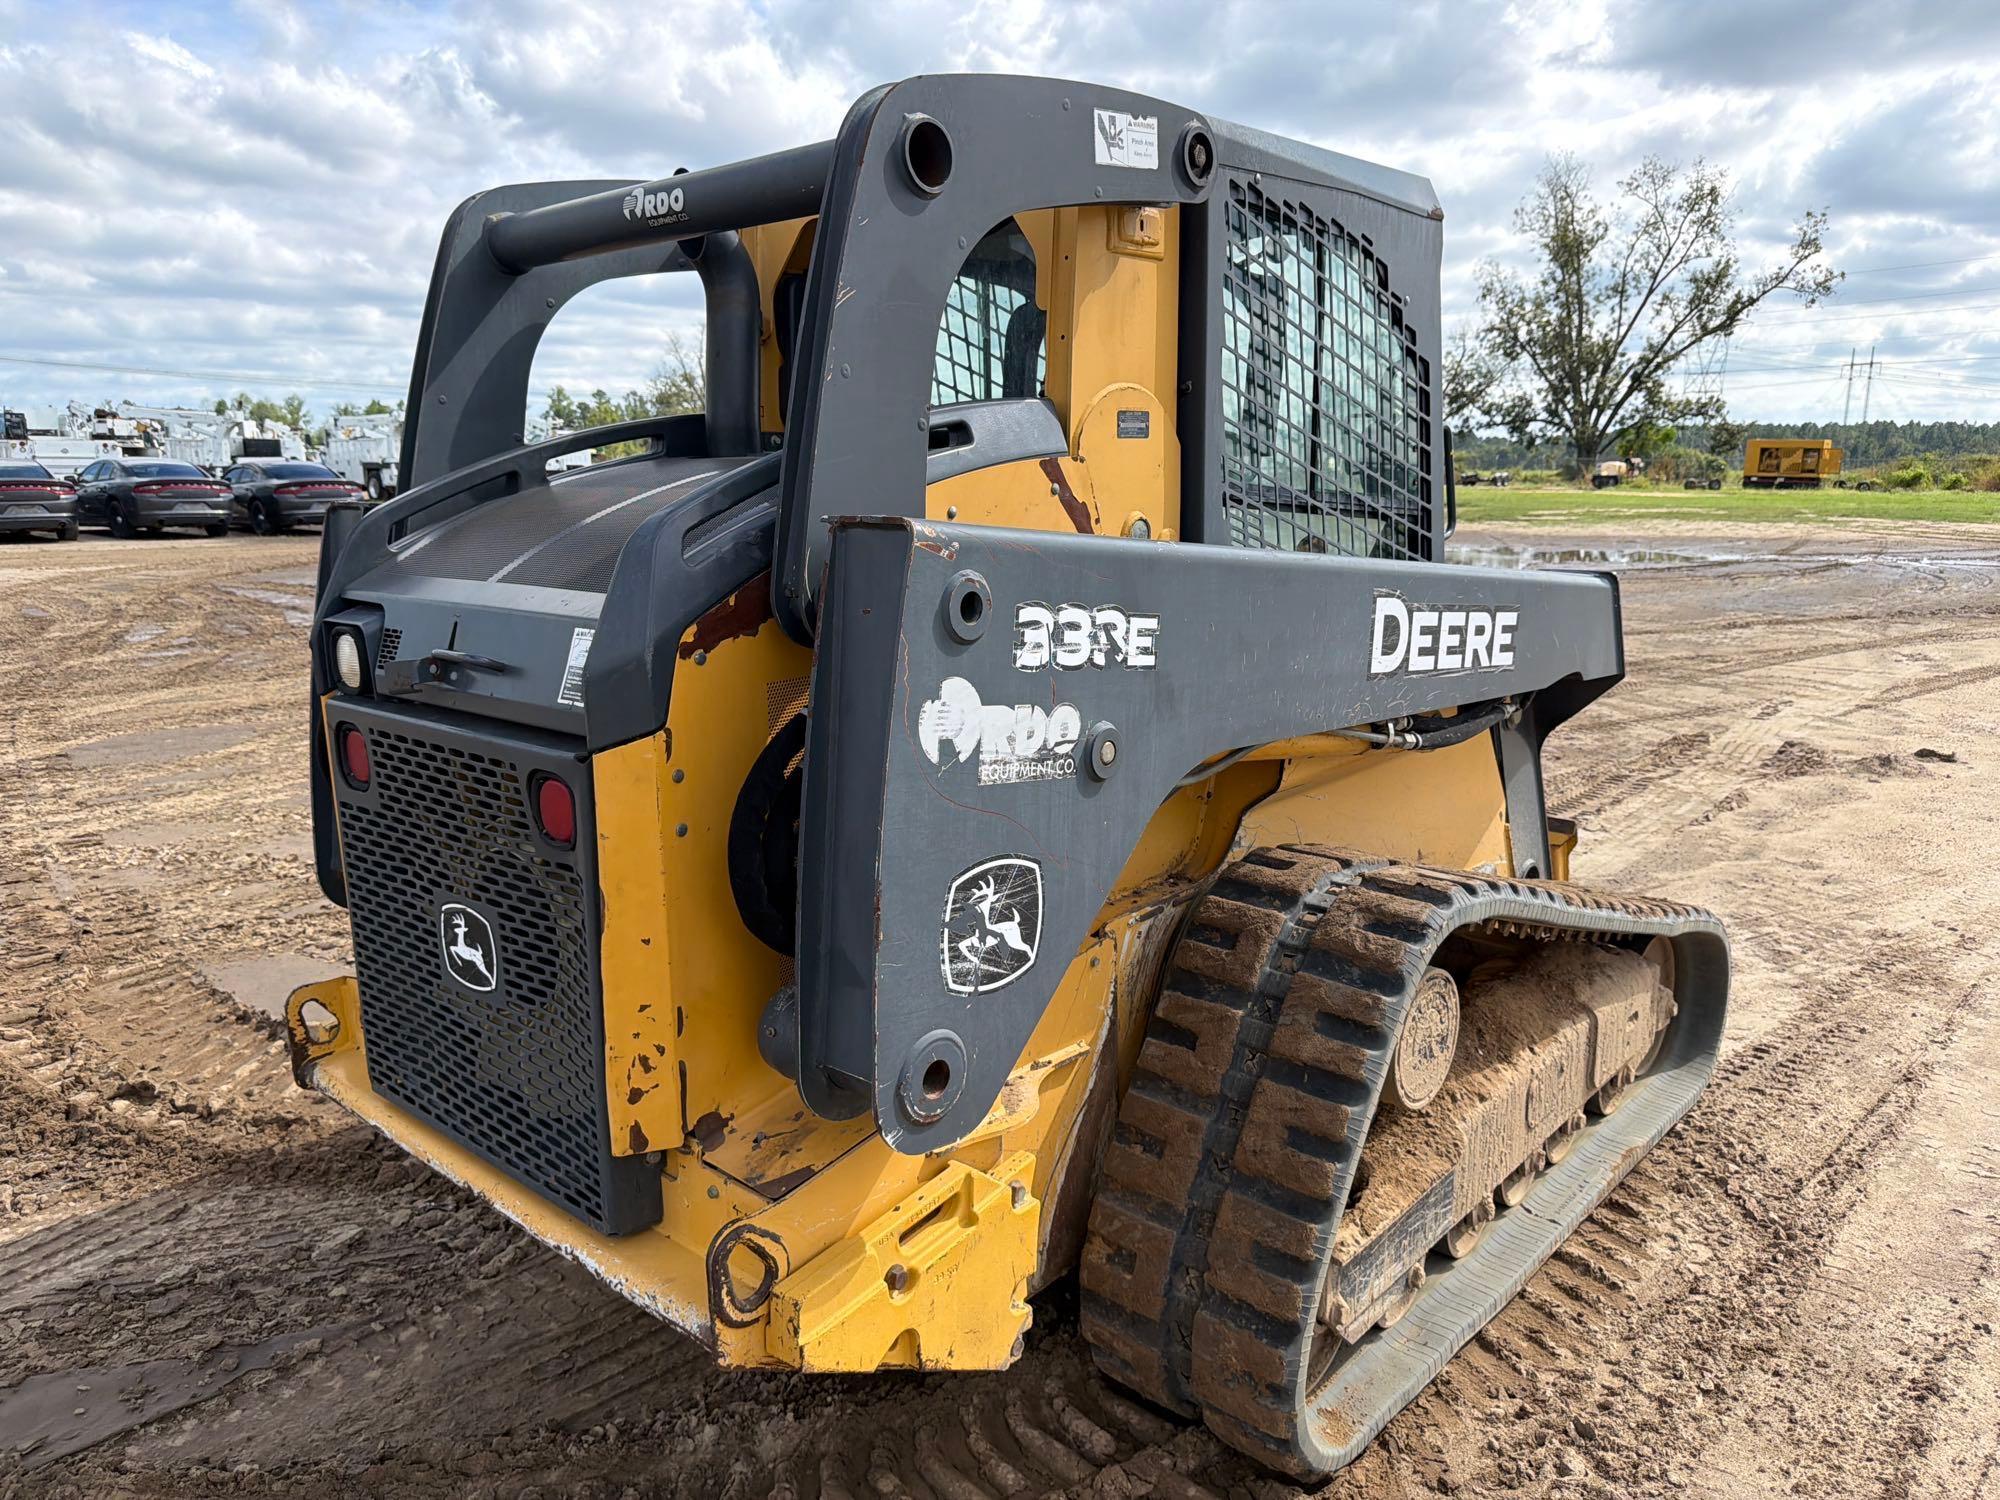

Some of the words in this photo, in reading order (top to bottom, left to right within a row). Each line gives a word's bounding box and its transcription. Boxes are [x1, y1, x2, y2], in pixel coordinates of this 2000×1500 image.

[1132, 120, 1155, 130] WARNING
[1371, 597, 1518, 674] DEERE
[980, 760, 1054, 781] EQUIPMENT
[1056, 758, 1077, 775] CO.
